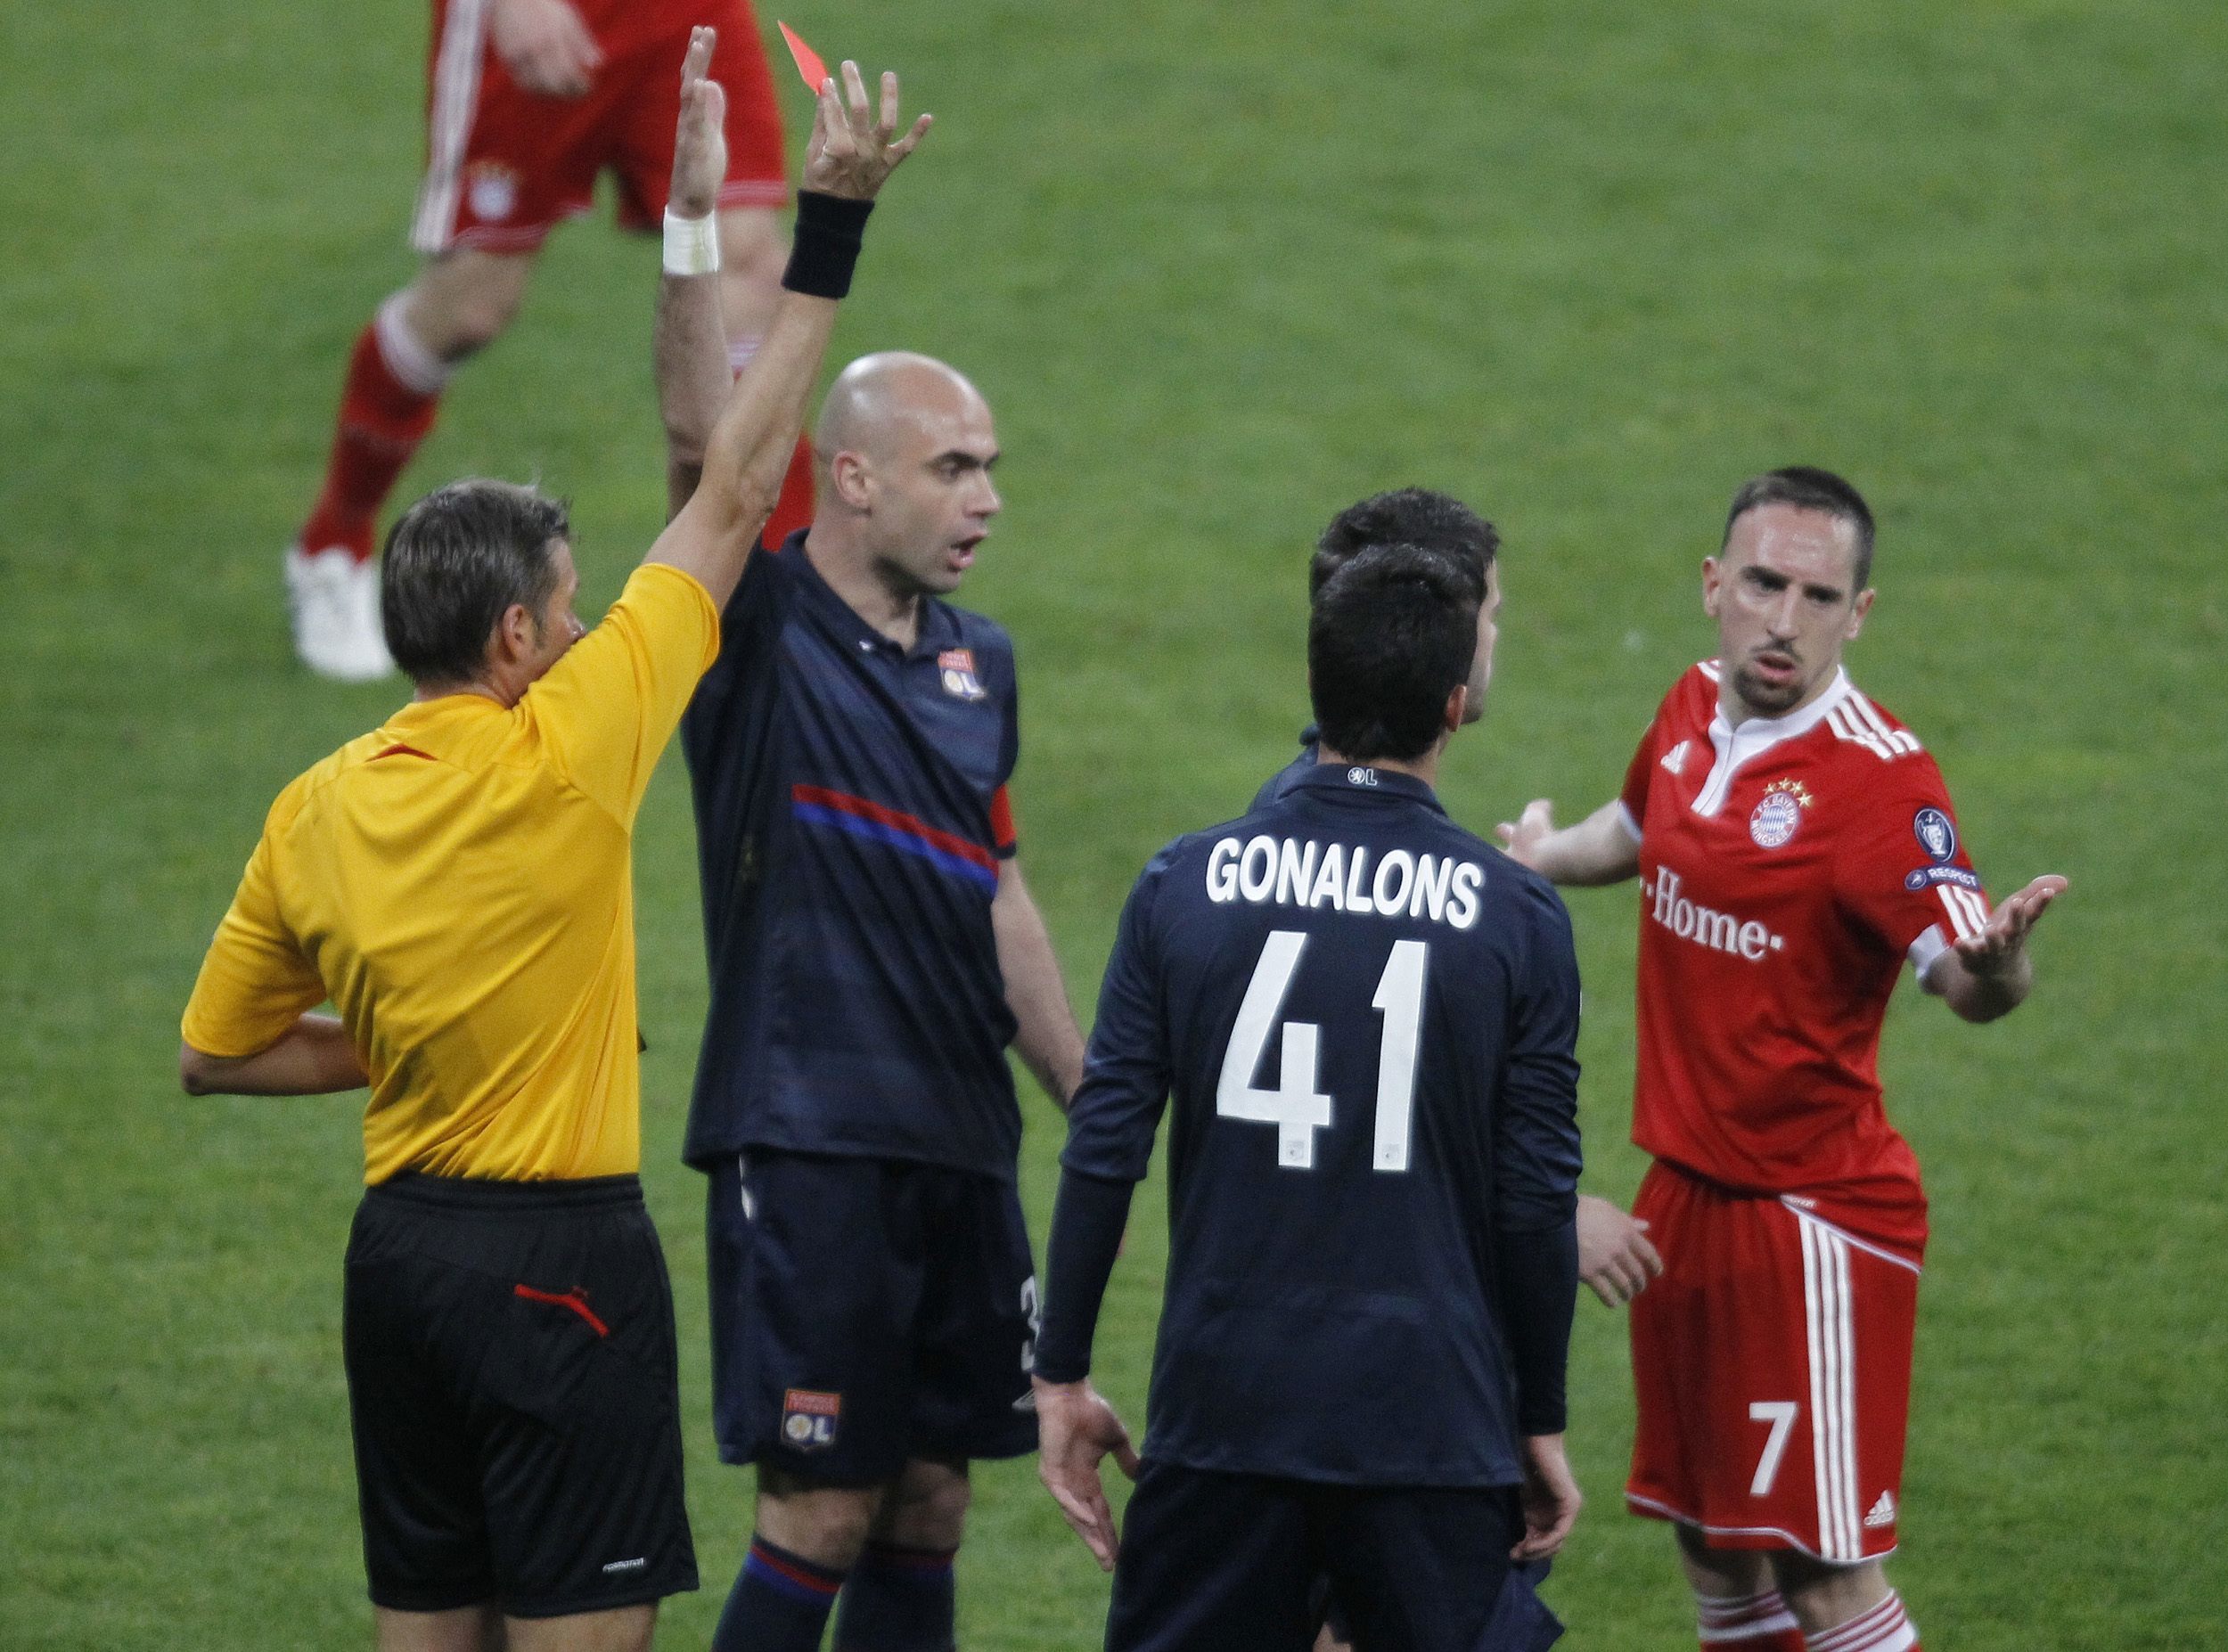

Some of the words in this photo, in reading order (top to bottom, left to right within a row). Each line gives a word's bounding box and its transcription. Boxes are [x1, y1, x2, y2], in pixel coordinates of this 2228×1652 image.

[1206, 835, 1485, 928] GONALONS
[1216, 930, 1428, 1172] 41
[1749, 1402, 1798, 1497] 7
